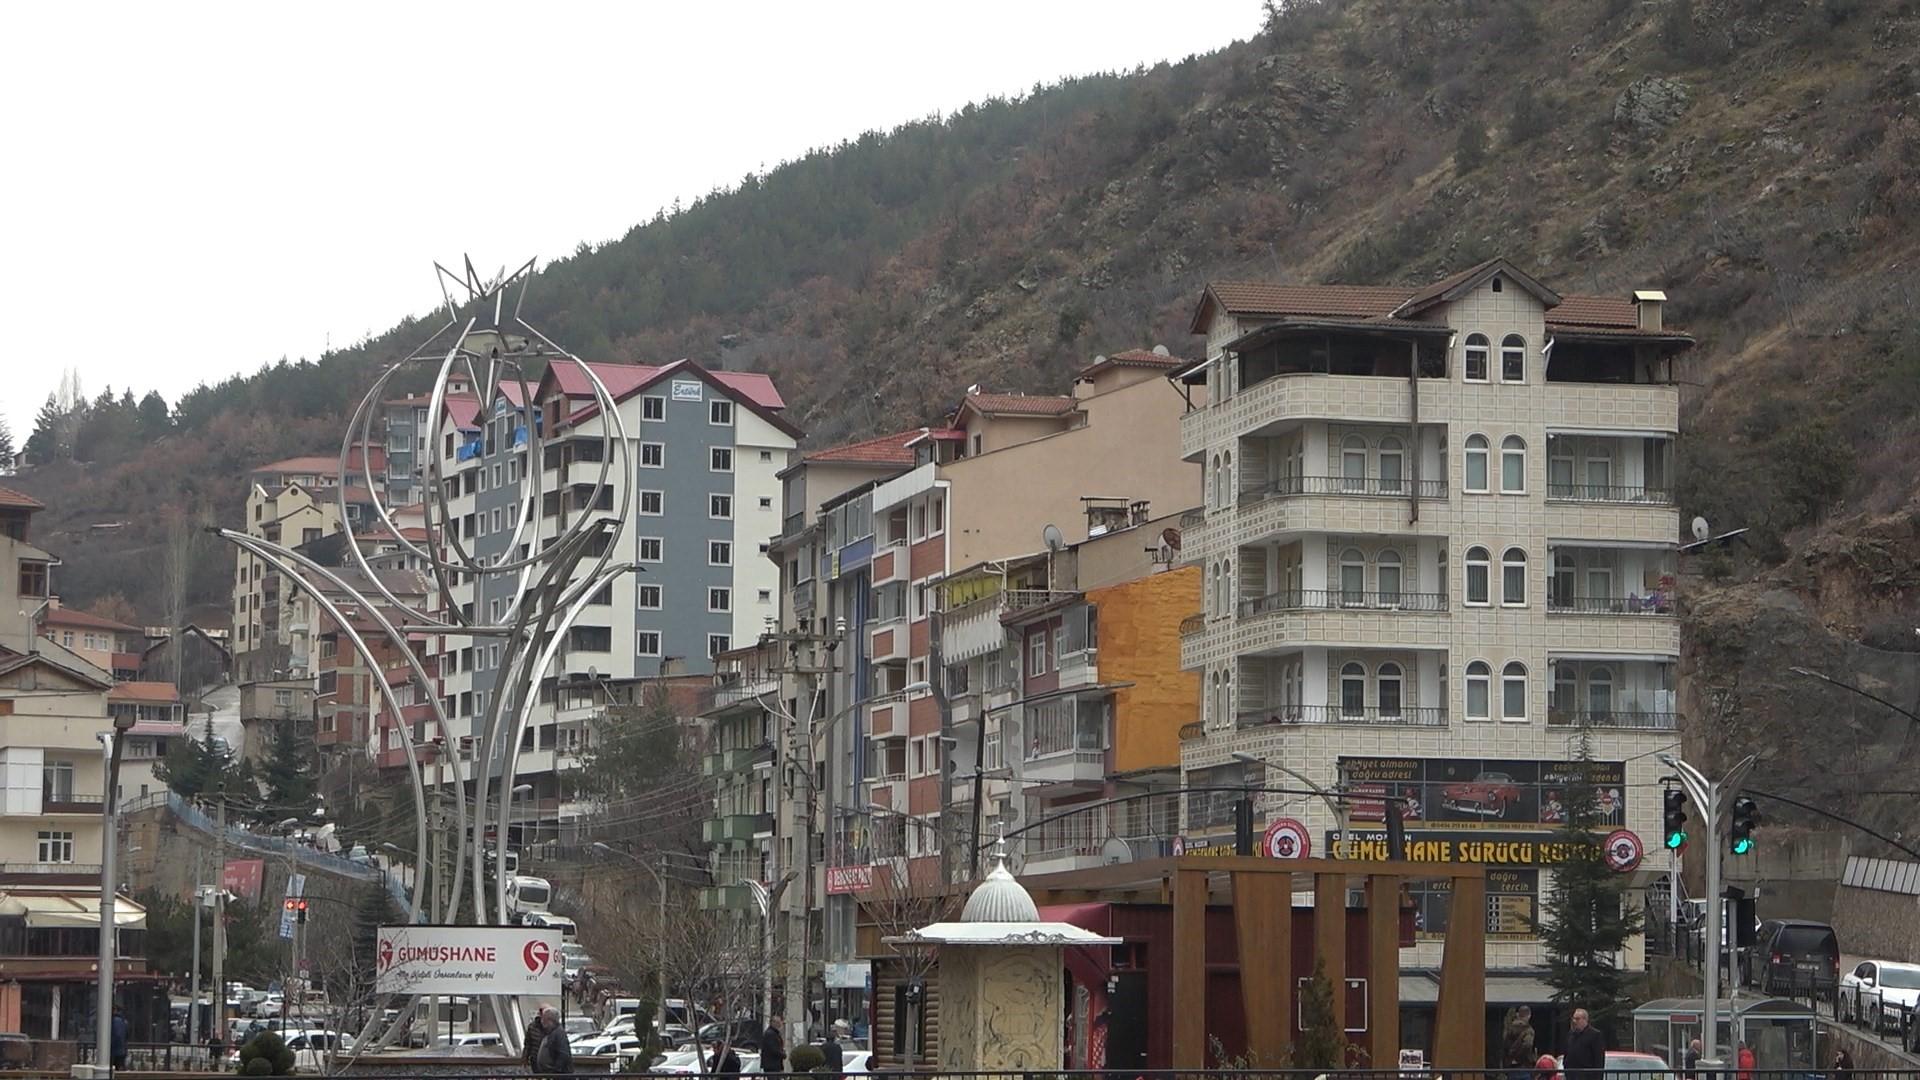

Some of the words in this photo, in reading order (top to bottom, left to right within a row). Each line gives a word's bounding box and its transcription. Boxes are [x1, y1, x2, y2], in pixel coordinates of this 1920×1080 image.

[1332, 840, 1451, 861] GÜMÜHANE
[1459, 841, 1533, 864] SÜRÜCÜ
[399, 946, 496, 963] GÜMÜŞHANE
